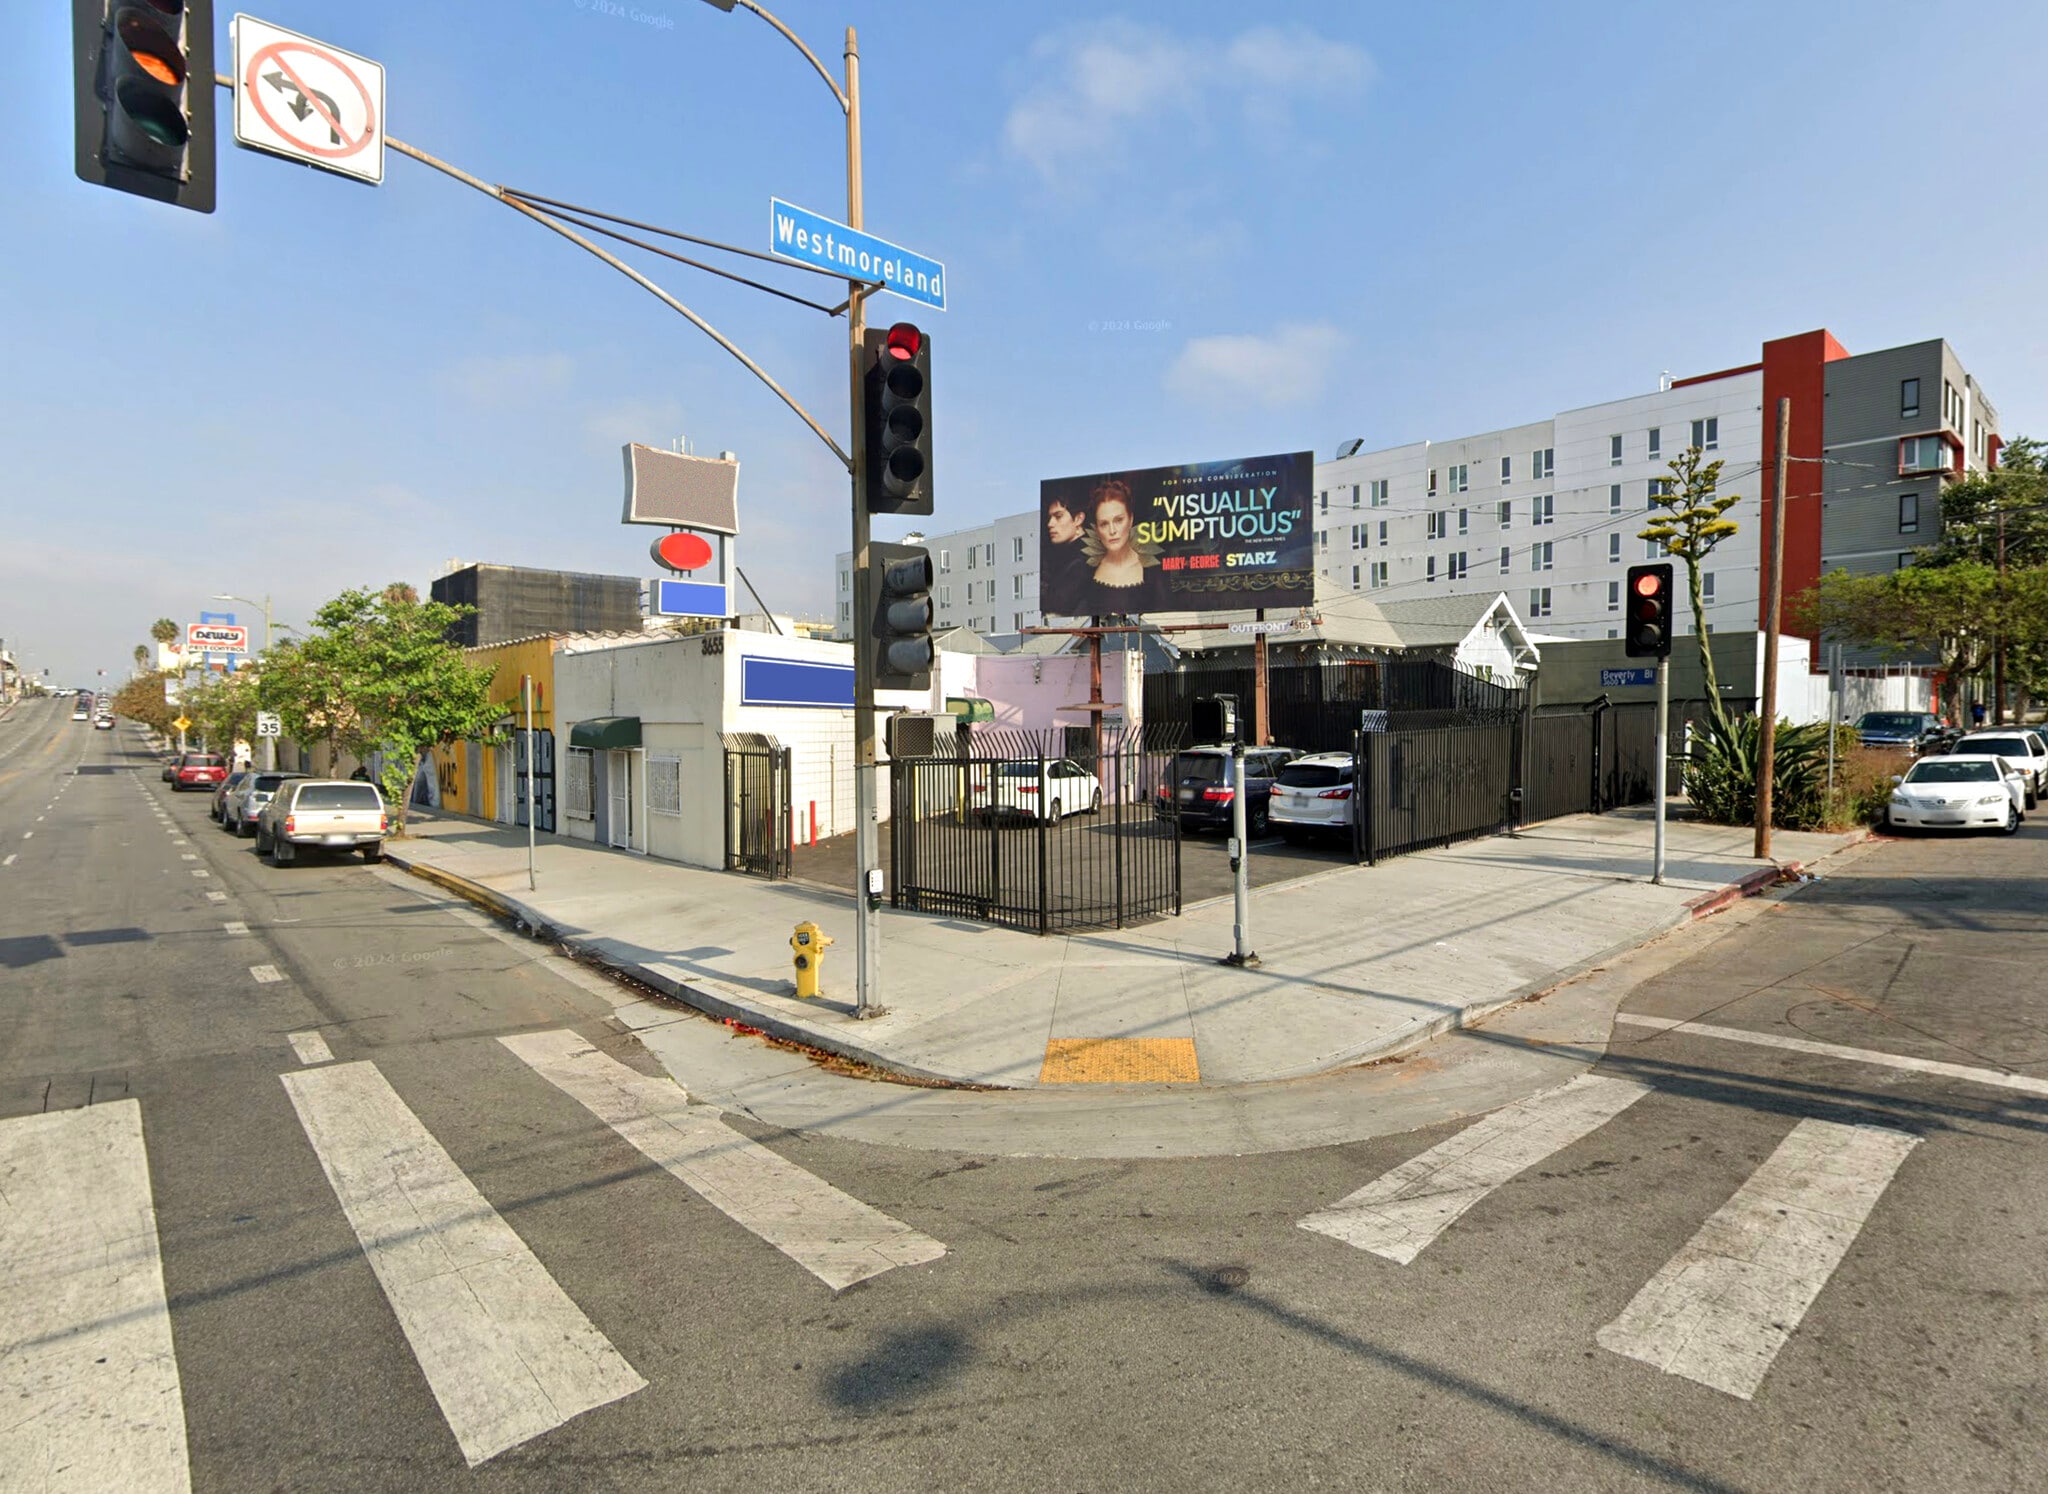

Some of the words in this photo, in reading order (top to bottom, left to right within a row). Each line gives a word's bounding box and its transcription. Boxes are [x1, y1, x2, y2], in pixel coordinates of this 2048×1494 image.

[776, 213, 942, 298] Westmoreland
[1182, 476, 1203, 485] YOUR
[1207, 470, 1278, 481] CONSIDERATION
[1162, 556, 1185, 570] MARY
[1190, 554, 1220, 569] GEORGE
[1226, 551, 1277, 567] STARZ
[196, 631, 239, 640] DEWEY
[1230, 622, 1287, 634] OUTFRONT
[701, 635, 724, 656] 3655
[1603, 670, 1635, 681] Beverly
[1644, 669, 1654, 679] Bl
[260, 722, 279, 734] 35
[439, 761, 458, 797] MAC
